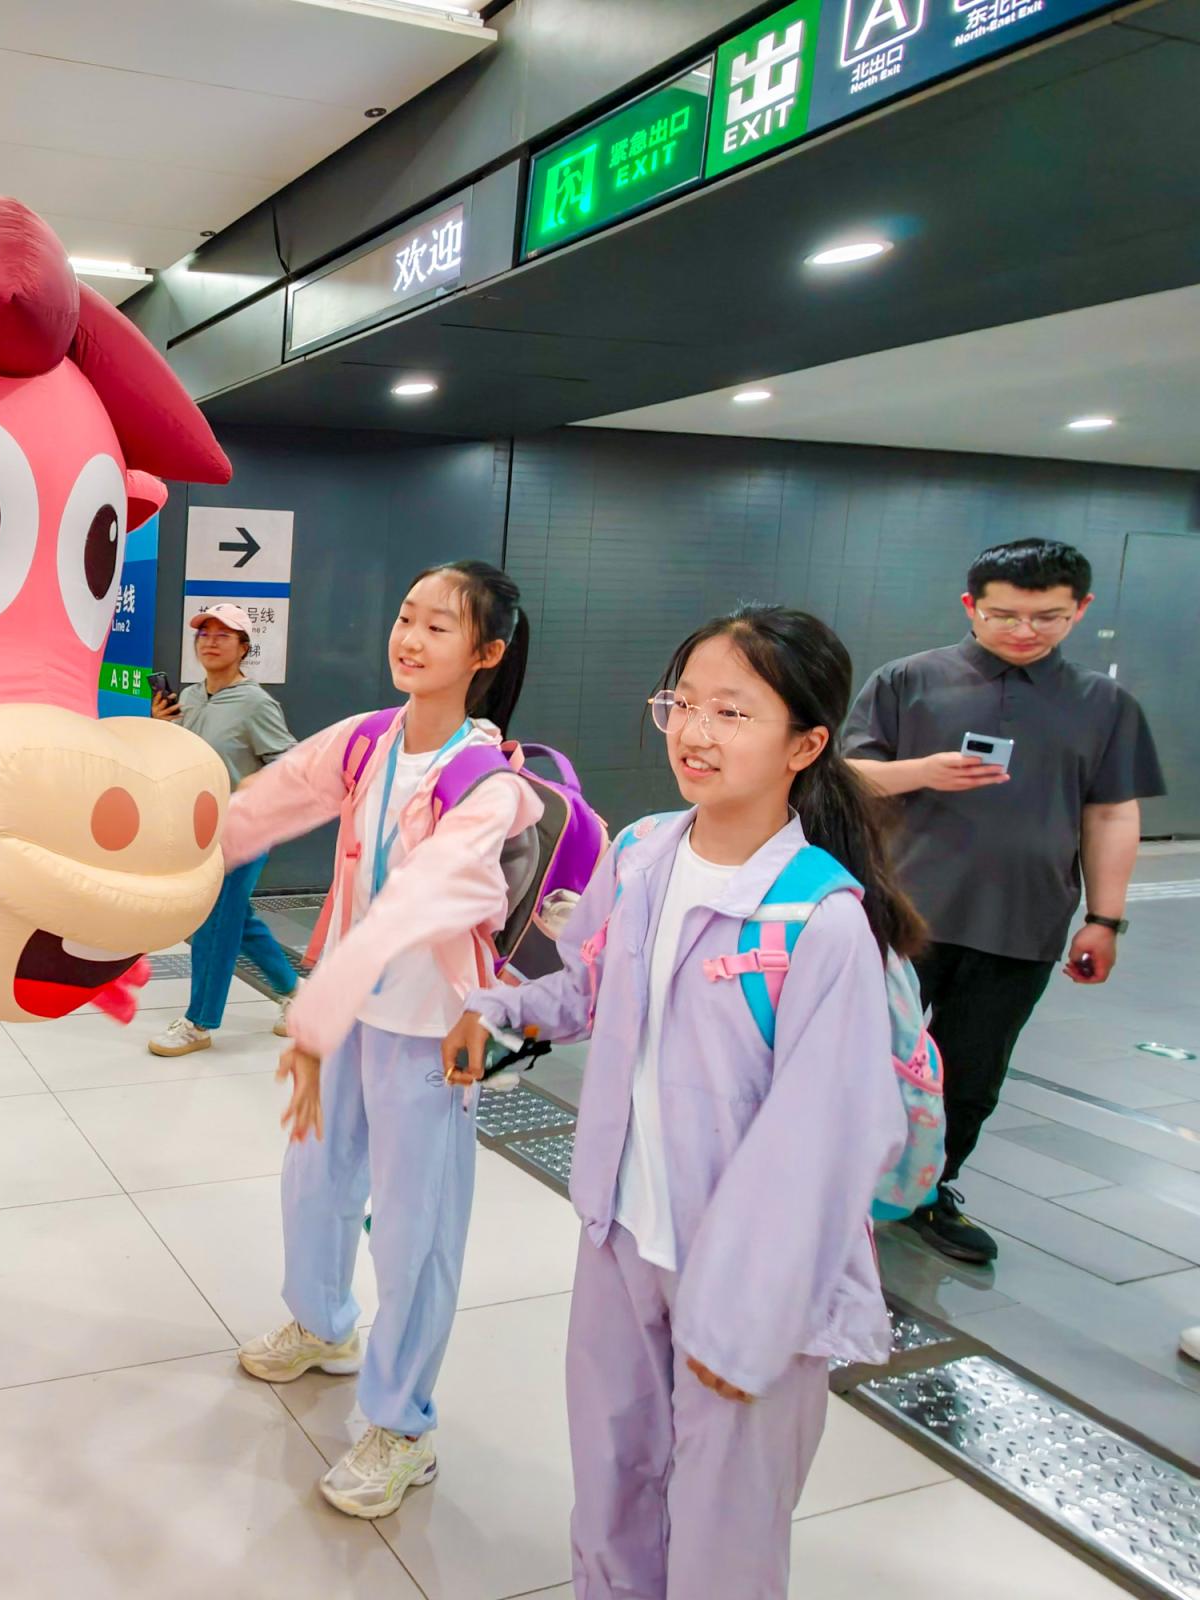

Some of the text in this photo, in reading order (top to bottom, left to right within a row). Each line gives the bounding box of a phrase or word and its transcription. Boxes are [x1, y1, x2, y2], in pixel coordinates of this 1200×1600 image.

[854, 0, 907, 51] A
[954, 0, 1043, 47] North-East Exit
[965, 0, 1032, 31] 东北
[726, 20, 803, 125] 出
[850, 44, 904, 83] 北出口
[850, 63, 901, 94] North Exit
[609, 106, 690, 168] 紧急出口
[723, 97, 794, 154] EXIT
[615, 141, 676, 188] EXIT
[393, 220, 464, 291] 欢迎
[112, 620, 131, 632] Line 2
